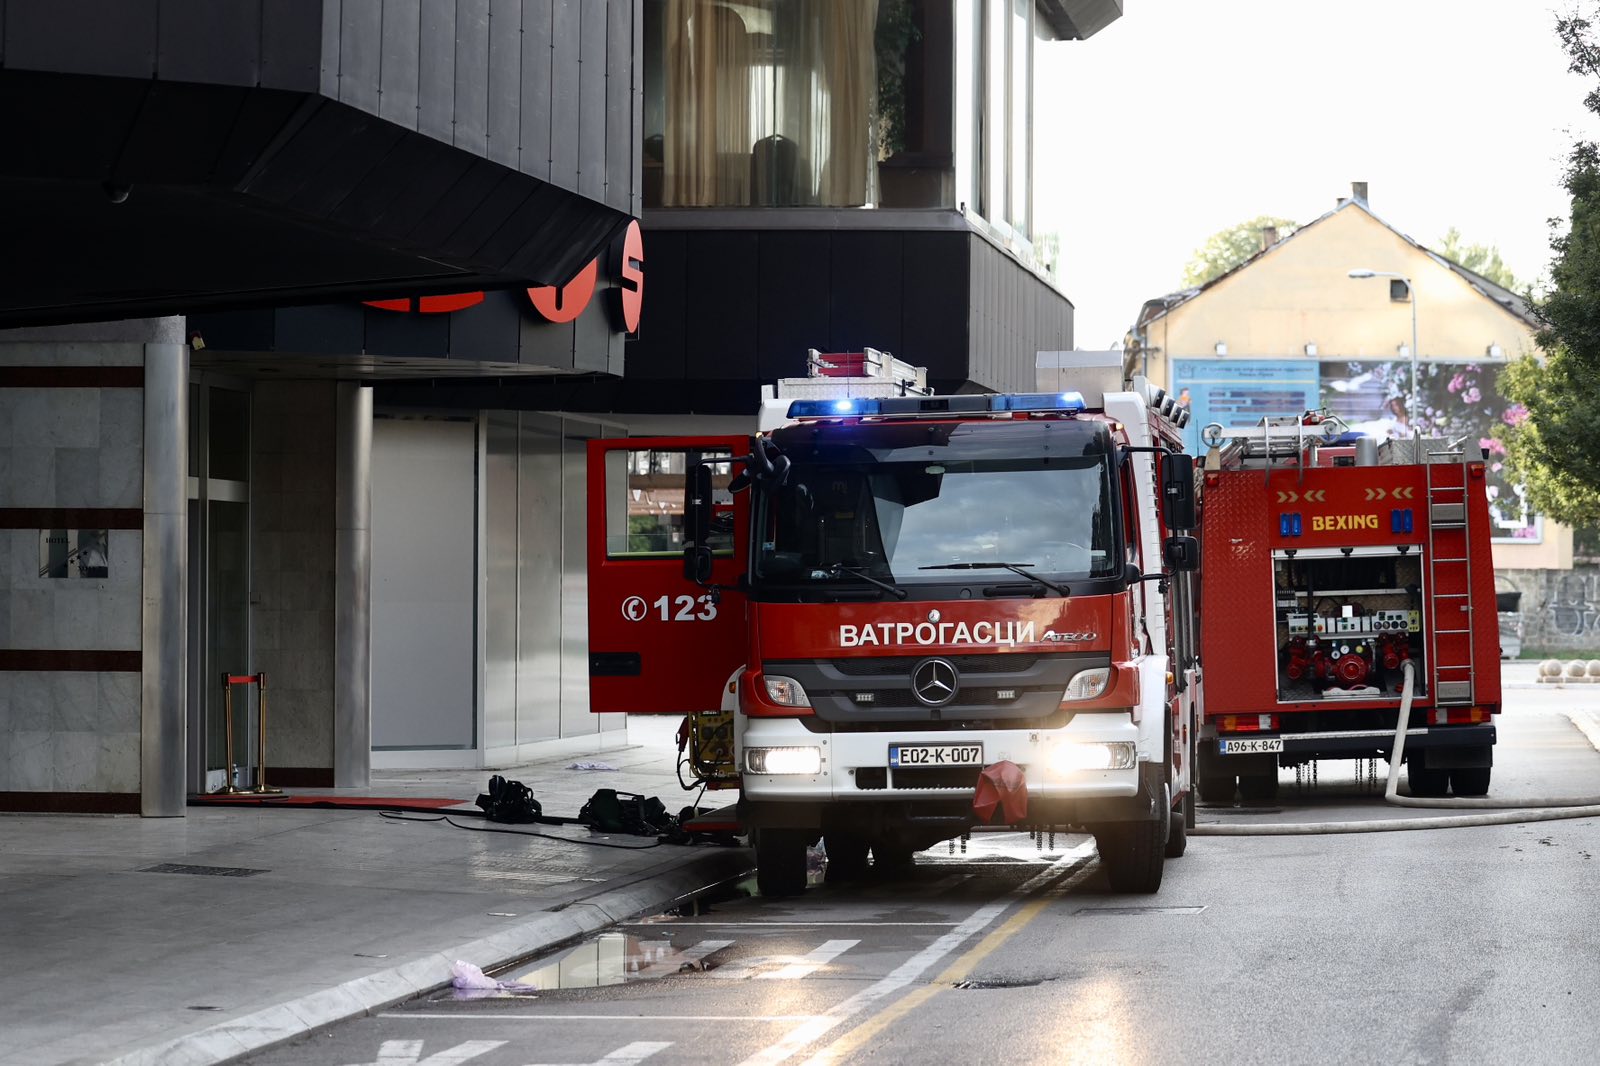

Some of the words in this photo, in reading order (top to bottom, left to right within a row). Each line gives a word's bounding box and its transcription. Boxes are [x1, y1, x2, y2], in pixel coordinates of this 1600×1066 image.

[1312, 514, 1379, 532] BEXING
[653, 595, 718, 622] 123
[839, 620, 1036, 648] ВАТРОГАСЦИ
[900, 747, 980, 764] E02-K-007
[1227, 740, 1282, 753] A96-K-847
